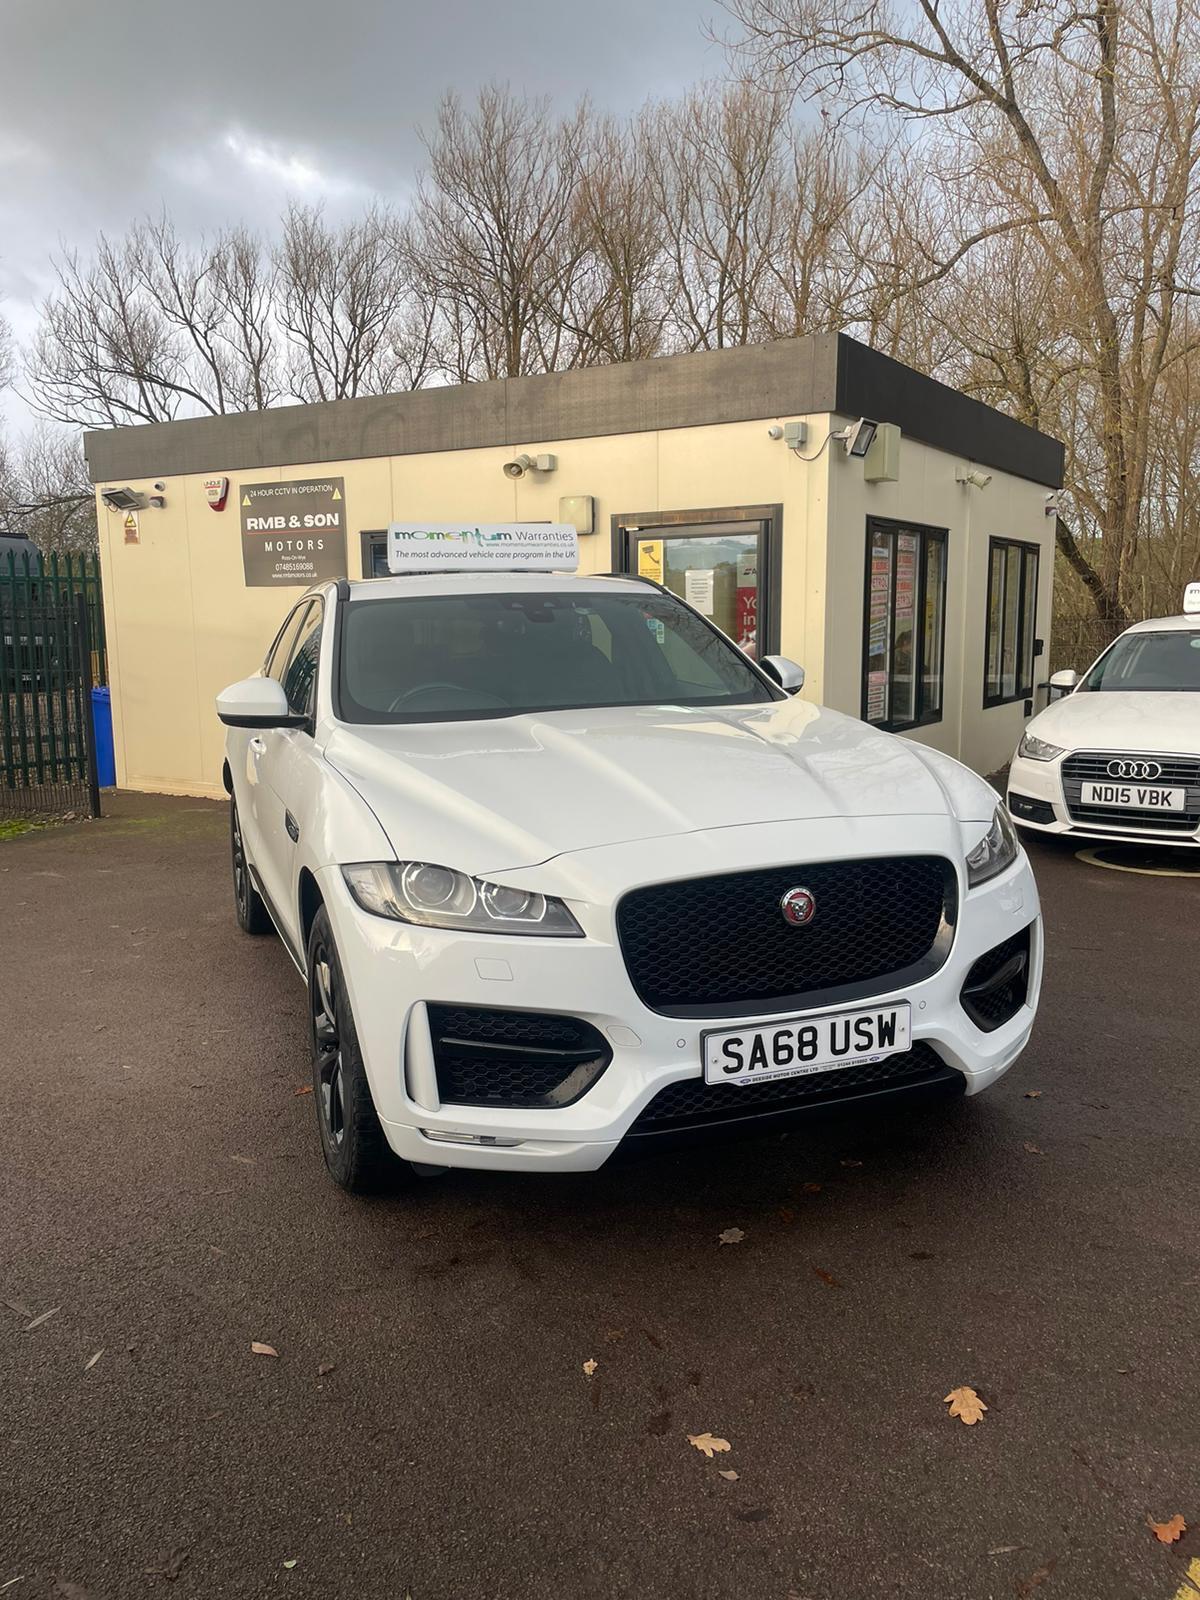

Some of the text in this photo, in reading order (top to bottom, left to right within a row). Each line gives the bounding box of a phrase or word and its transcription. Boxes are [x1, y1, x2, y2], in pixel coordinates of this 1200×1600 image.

[257, 489, 274, 497] HOUR
[274, 488, 291, 496] CCTV
[291, 487, 298, 495] IN
[298, 484, 333, 494] OPERATION
[246, 513, 339, 530] RMB & SON
[264, 539, 324, 552] MOTORS
[394, 528, 574, 547] momentum Warranties
[395, 550, 409, 558] The
[430, 550, 467, 559] advanced
[468, 550, 494, 558] vehicle
[512, 551, 544, 560] program
[544, 550, 551, 558] in
[552, 550, 564, 558] the
[565, 550, 576, 558] UK
[1092, 785, 1172, 807] ND15 VBK
[722, 1012, 897, 1074] SA68 USW
